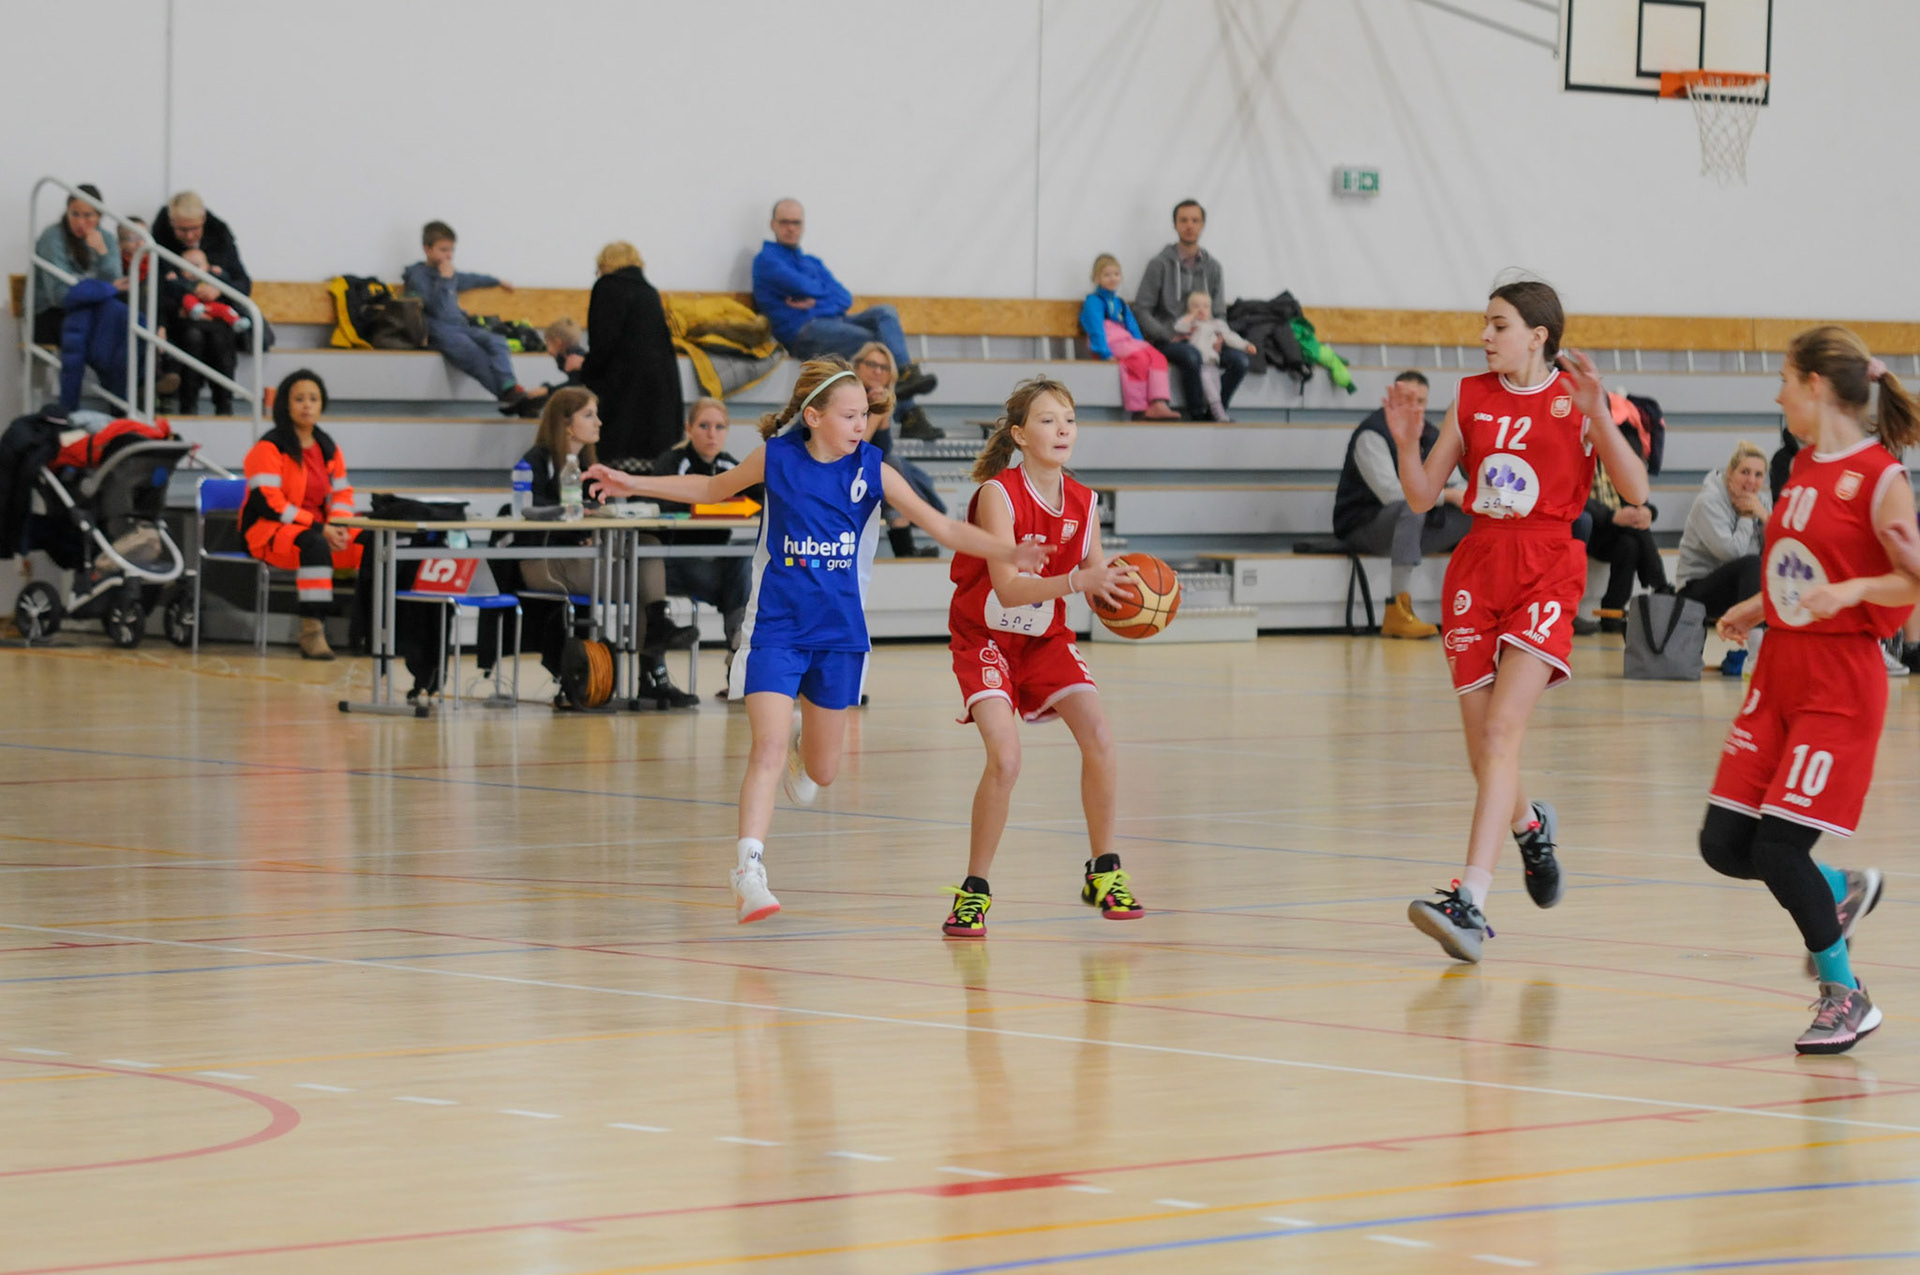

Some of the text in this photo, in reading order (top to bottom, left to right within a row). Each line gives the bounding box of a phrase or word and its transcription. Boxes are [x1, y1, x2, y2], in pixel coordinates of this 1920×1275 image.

[1495, 416, 1532, 450] 12
[850, 467, 868, 503] 6
[1781, 485, 1818, 532] 10
[783, 534, 840, 556] huber
[1527, 600, 1561, 639] 12
[1785, 744, 1834, 796] 10
